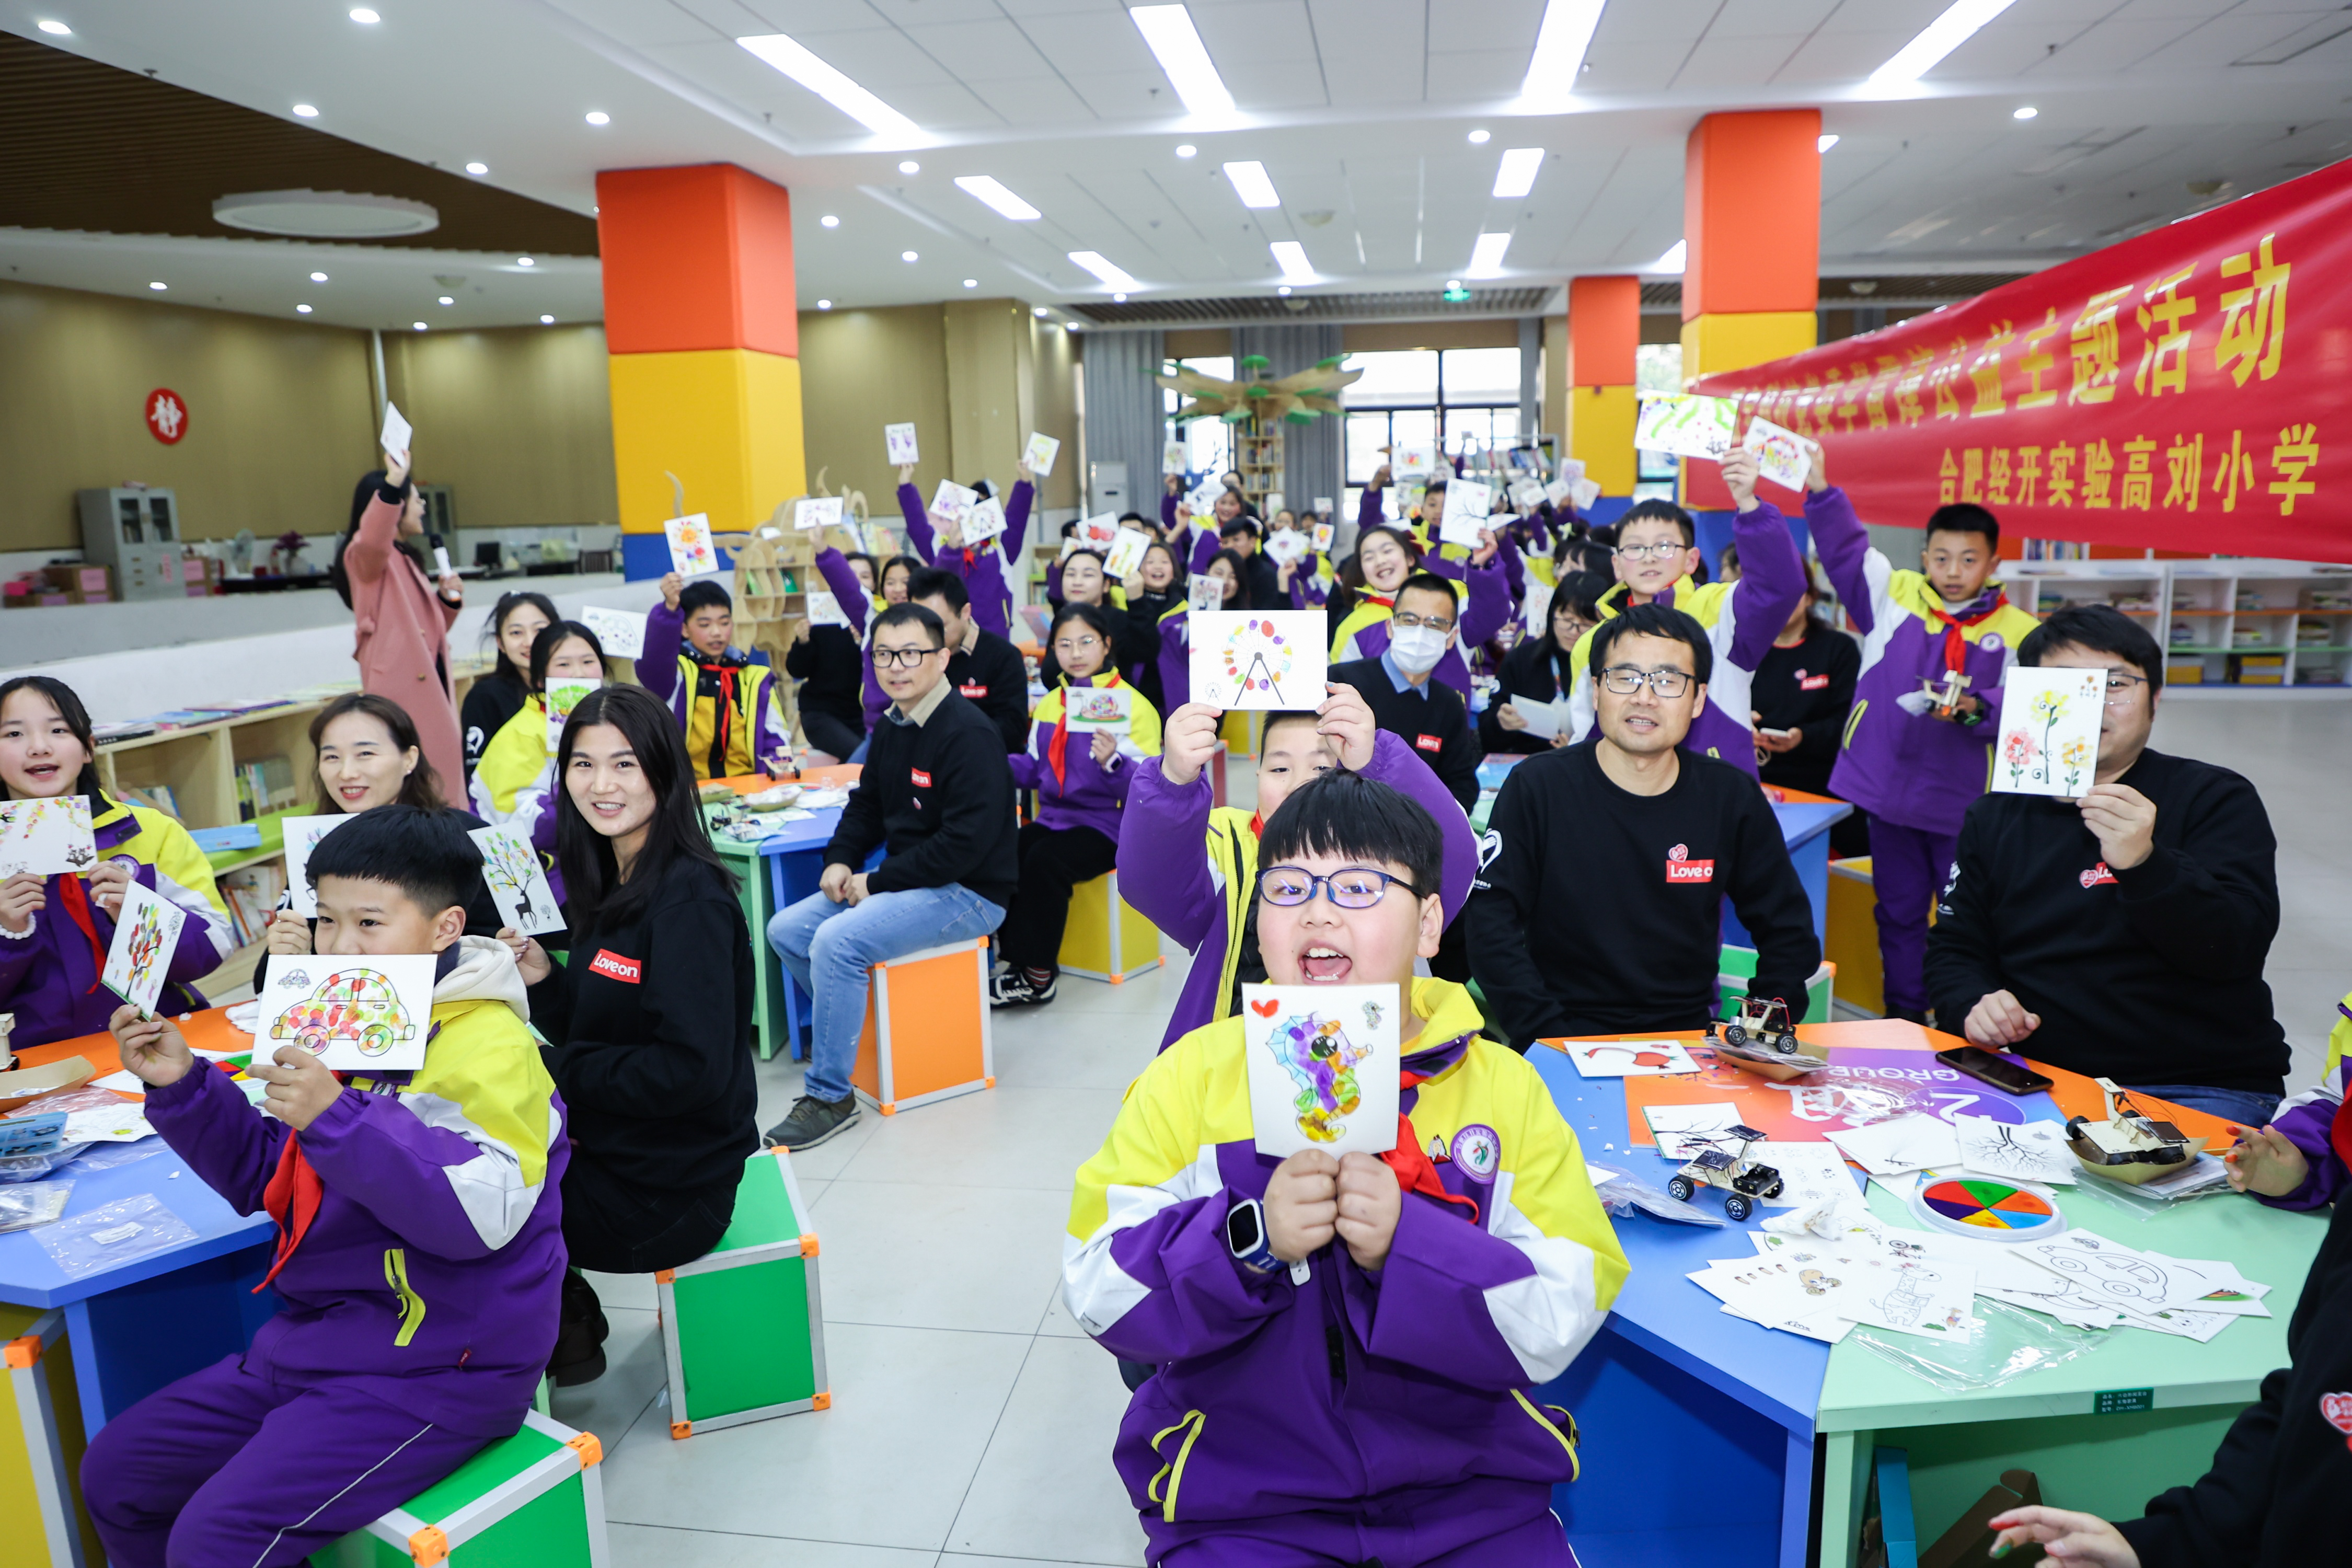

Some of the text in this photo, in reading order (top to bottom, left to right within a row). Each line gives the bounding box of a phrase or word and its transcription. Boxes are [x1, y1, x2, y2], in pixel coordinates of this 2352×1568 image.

[1939, 422, 2320, 516] 合肥经开实验高刘小学
[1828, 1066, 1960, 1081] GROUP
